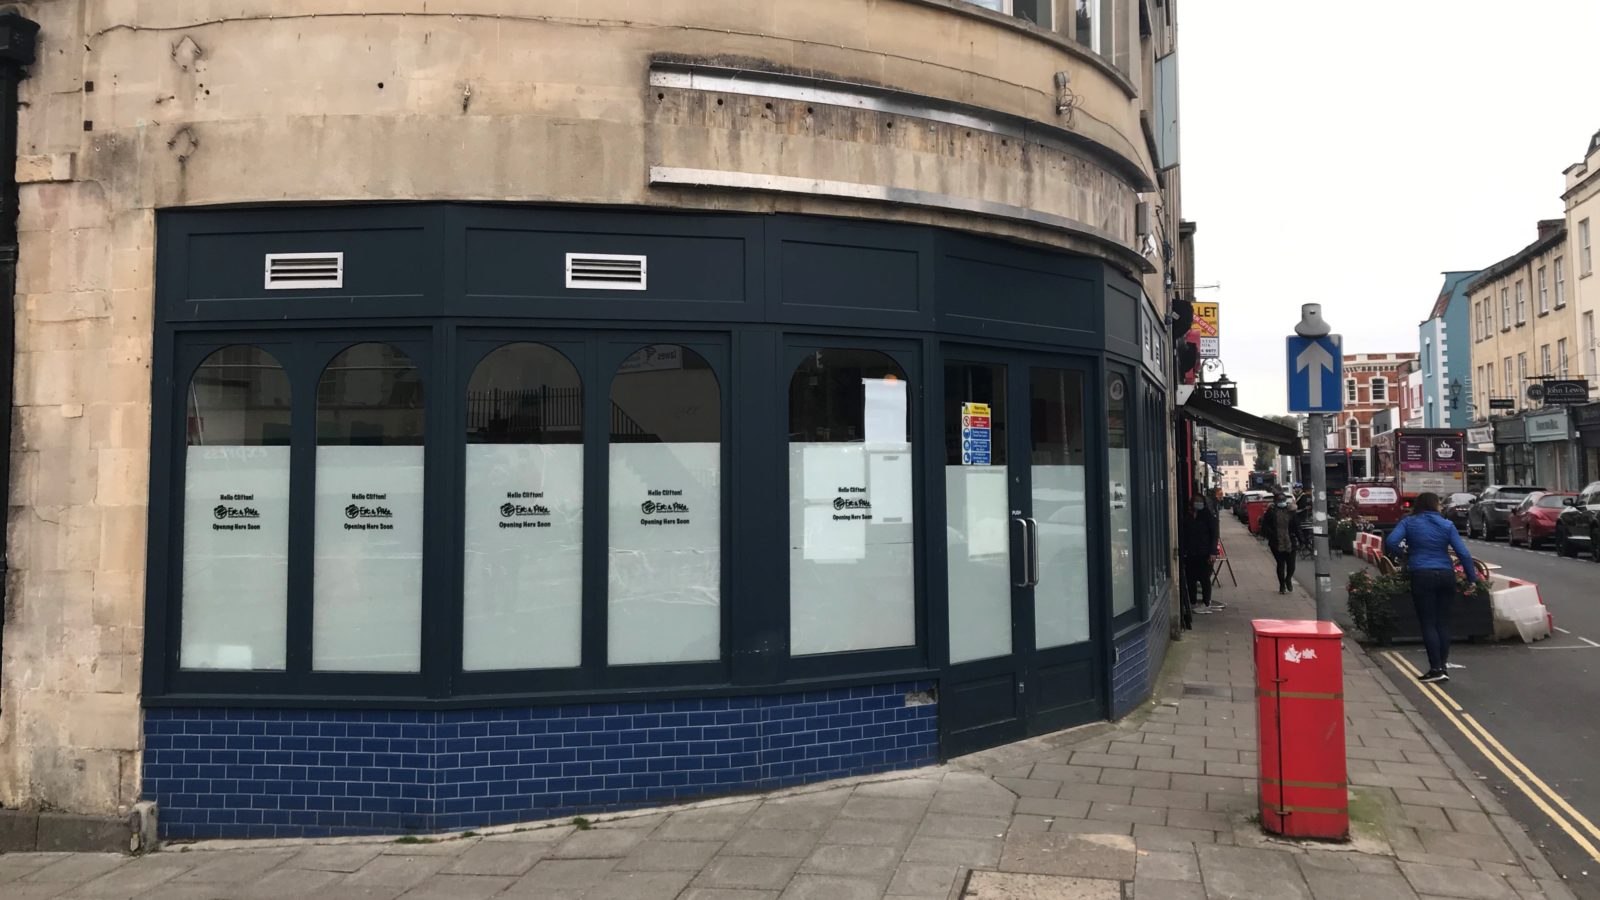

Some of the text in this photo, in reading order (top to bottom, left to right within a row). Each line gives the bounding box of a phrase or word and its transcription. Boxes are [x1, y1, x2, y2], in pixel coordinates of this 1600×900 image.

[1198, 307, 1216, 317] LET
[1199, 320, 1216, 335] OFFER
[1204, 389, 1230, 399] DBM
[1547, 386, 1586, 395] John Lewis
[640, 518, 662, 526] Opening
[213, 523, 234, 531] Opening
